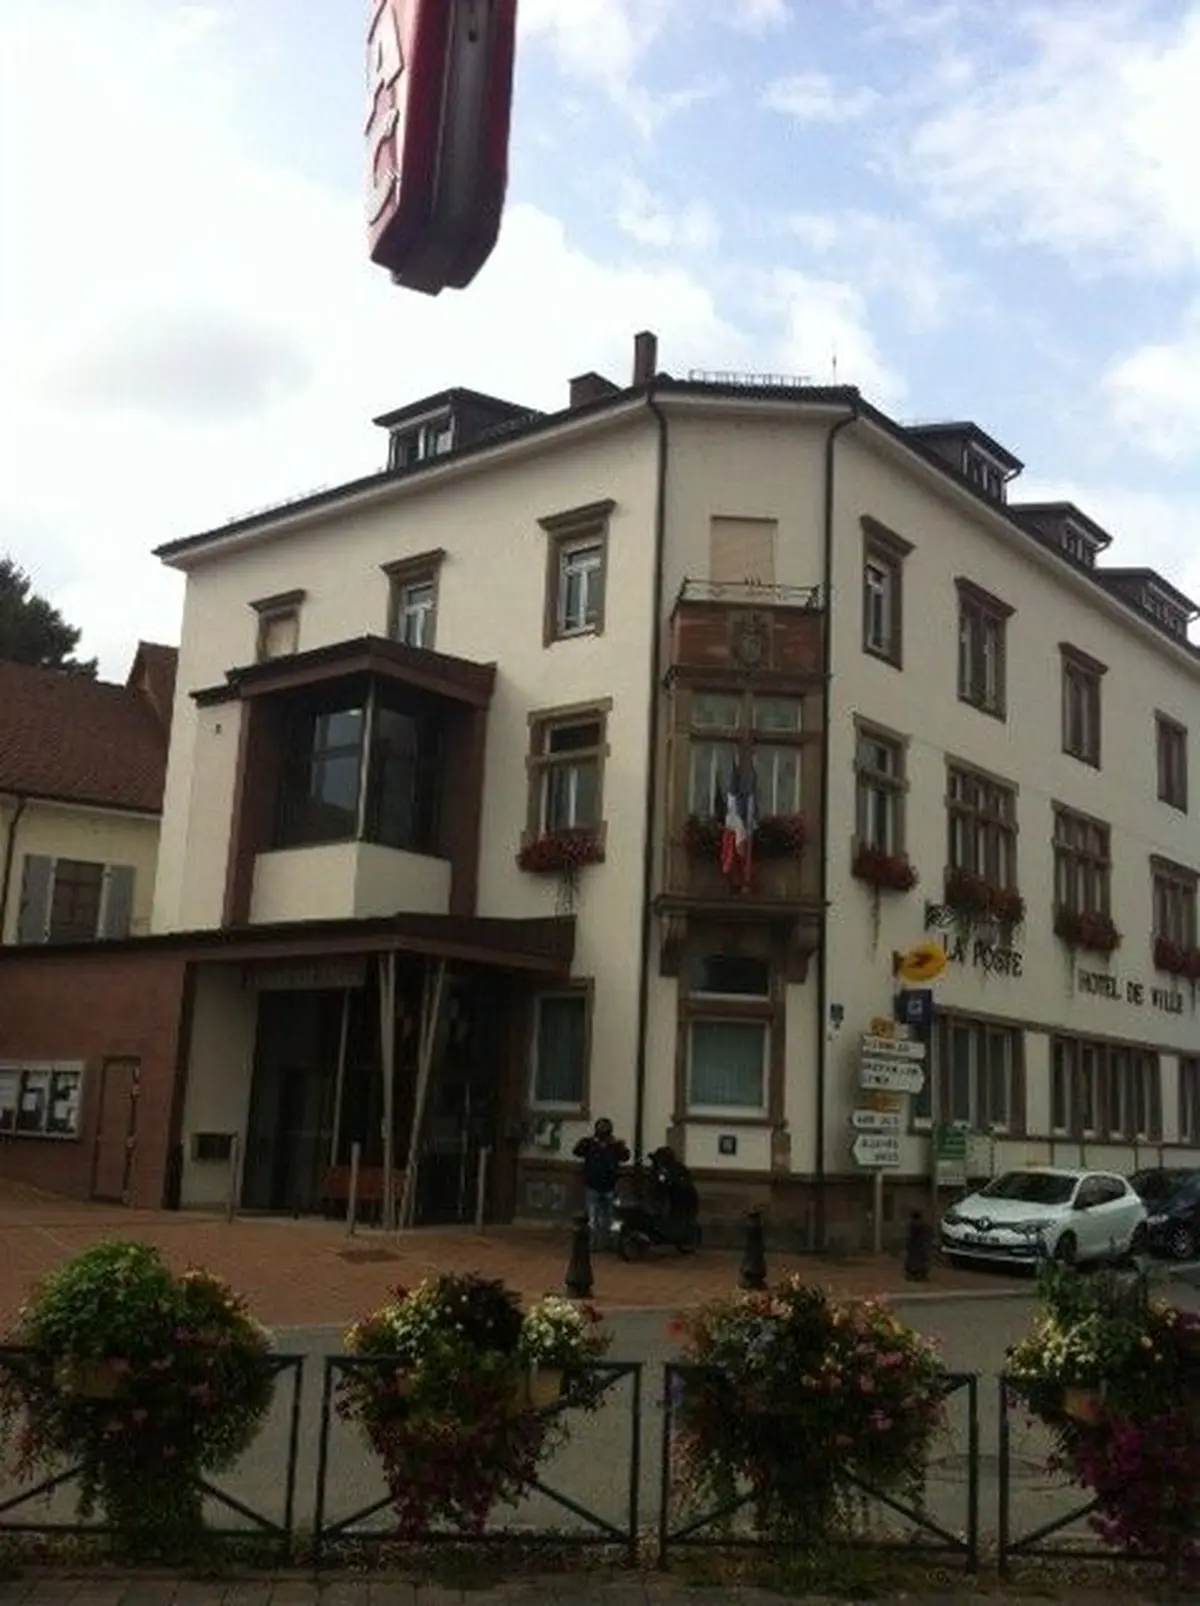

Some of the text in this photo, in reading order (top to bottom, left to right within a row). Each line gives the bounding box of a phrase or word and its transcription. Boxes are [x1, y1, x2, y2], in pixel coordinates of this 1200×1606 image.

[943, 933, 1022, 977] LA POSTE
[1126, 981, 1145, 1006] DE
[1150, 987, 1184, 1015] VILLE
